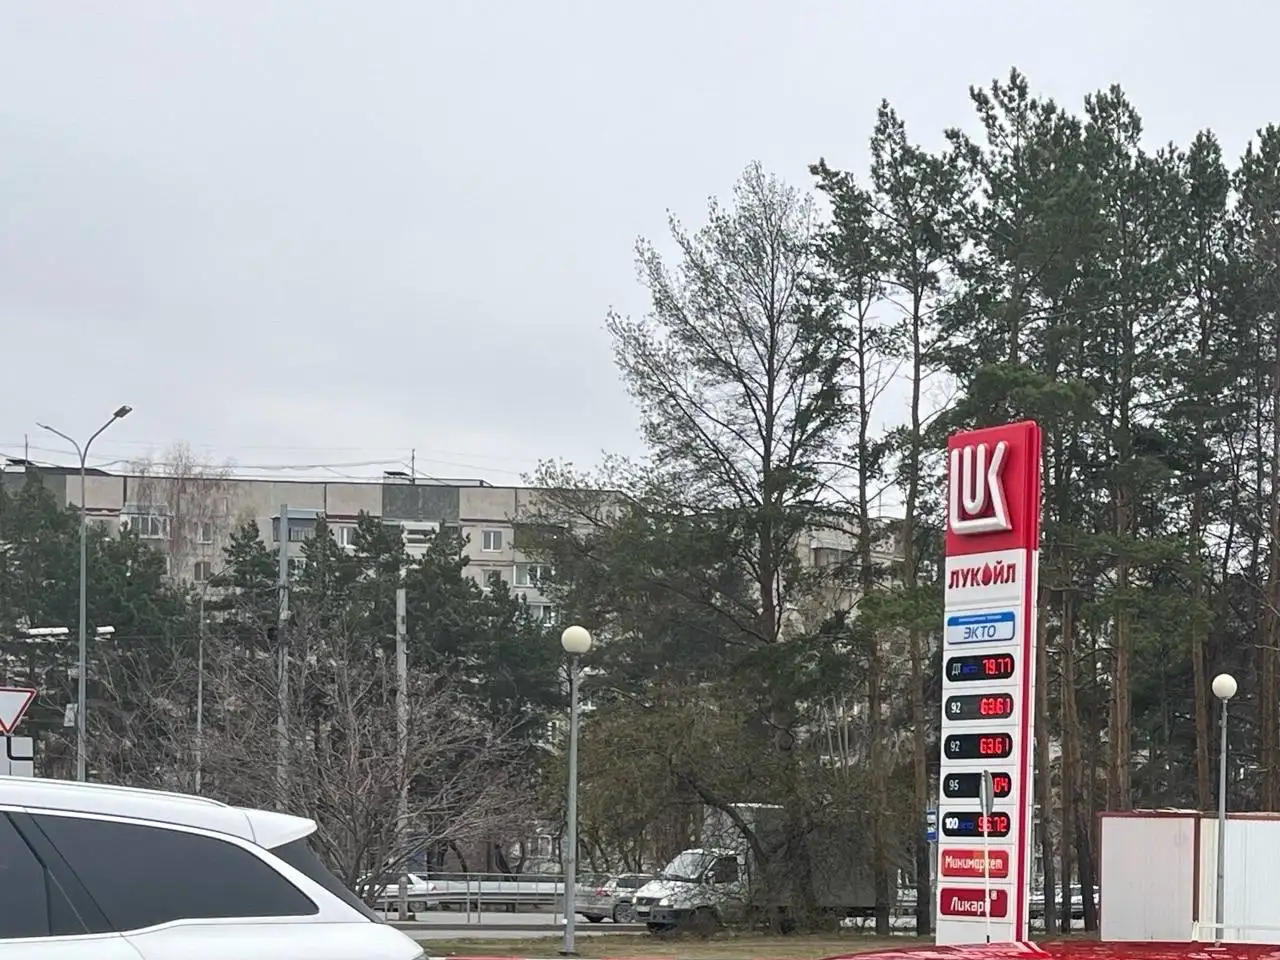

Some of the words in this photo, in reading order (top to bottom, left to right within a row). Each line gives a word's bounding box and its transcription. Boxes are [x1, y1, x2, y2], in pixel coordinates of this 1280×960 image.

[964, 624, 997, 640] ЭКТО
[951, 702, 961, 713] 92
[950, 741, 960, 752] 92
[949, 780, 959, 790] 95
[945, 818, 958, 829] 100
[945, 855, 1003, 872] Минимарет
